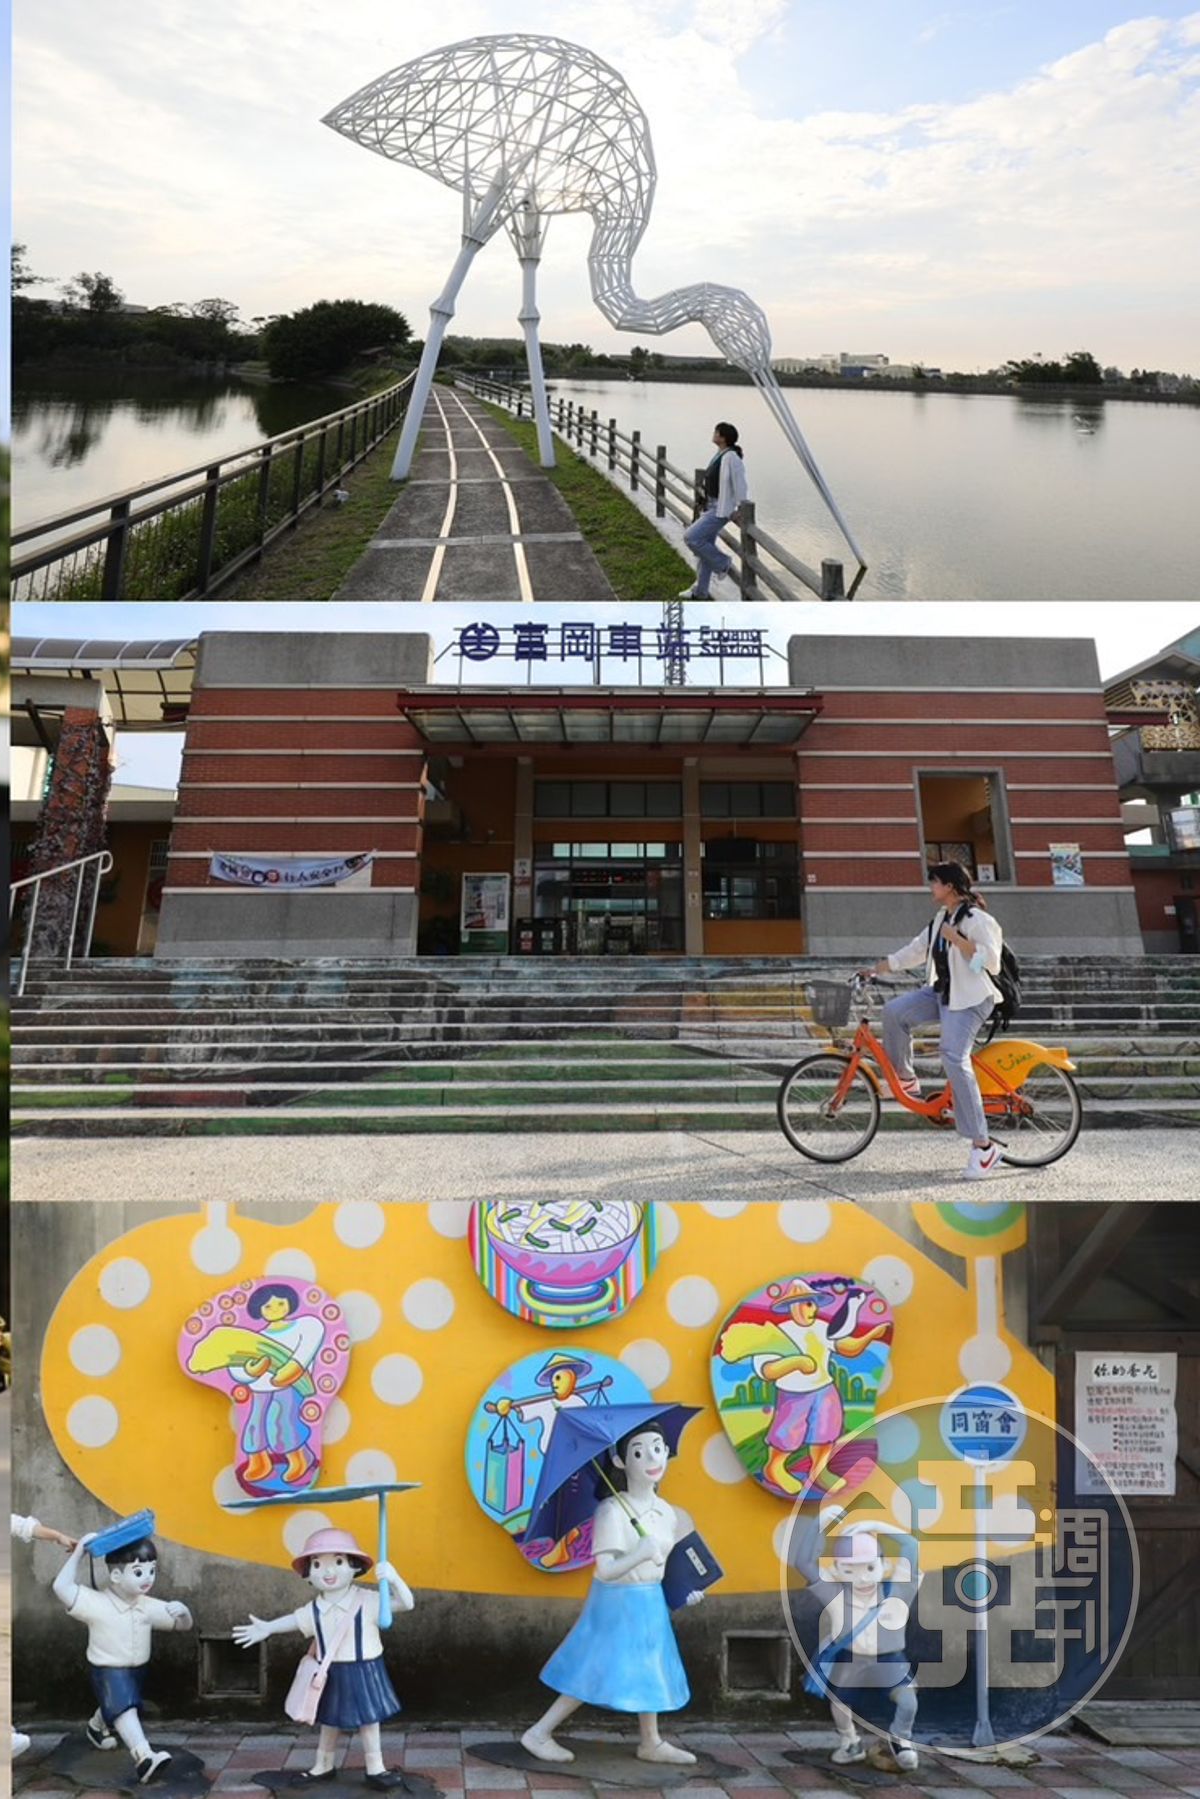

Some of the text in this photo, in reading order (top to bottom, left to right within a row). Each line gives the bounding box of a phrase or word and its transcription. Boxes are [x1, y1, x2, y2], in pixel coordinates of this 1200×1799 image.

[513, 622, 691, 662] 富岡車站
[699, 625, 762, 642] Fugang
[699, 641, 762, 657] Station
